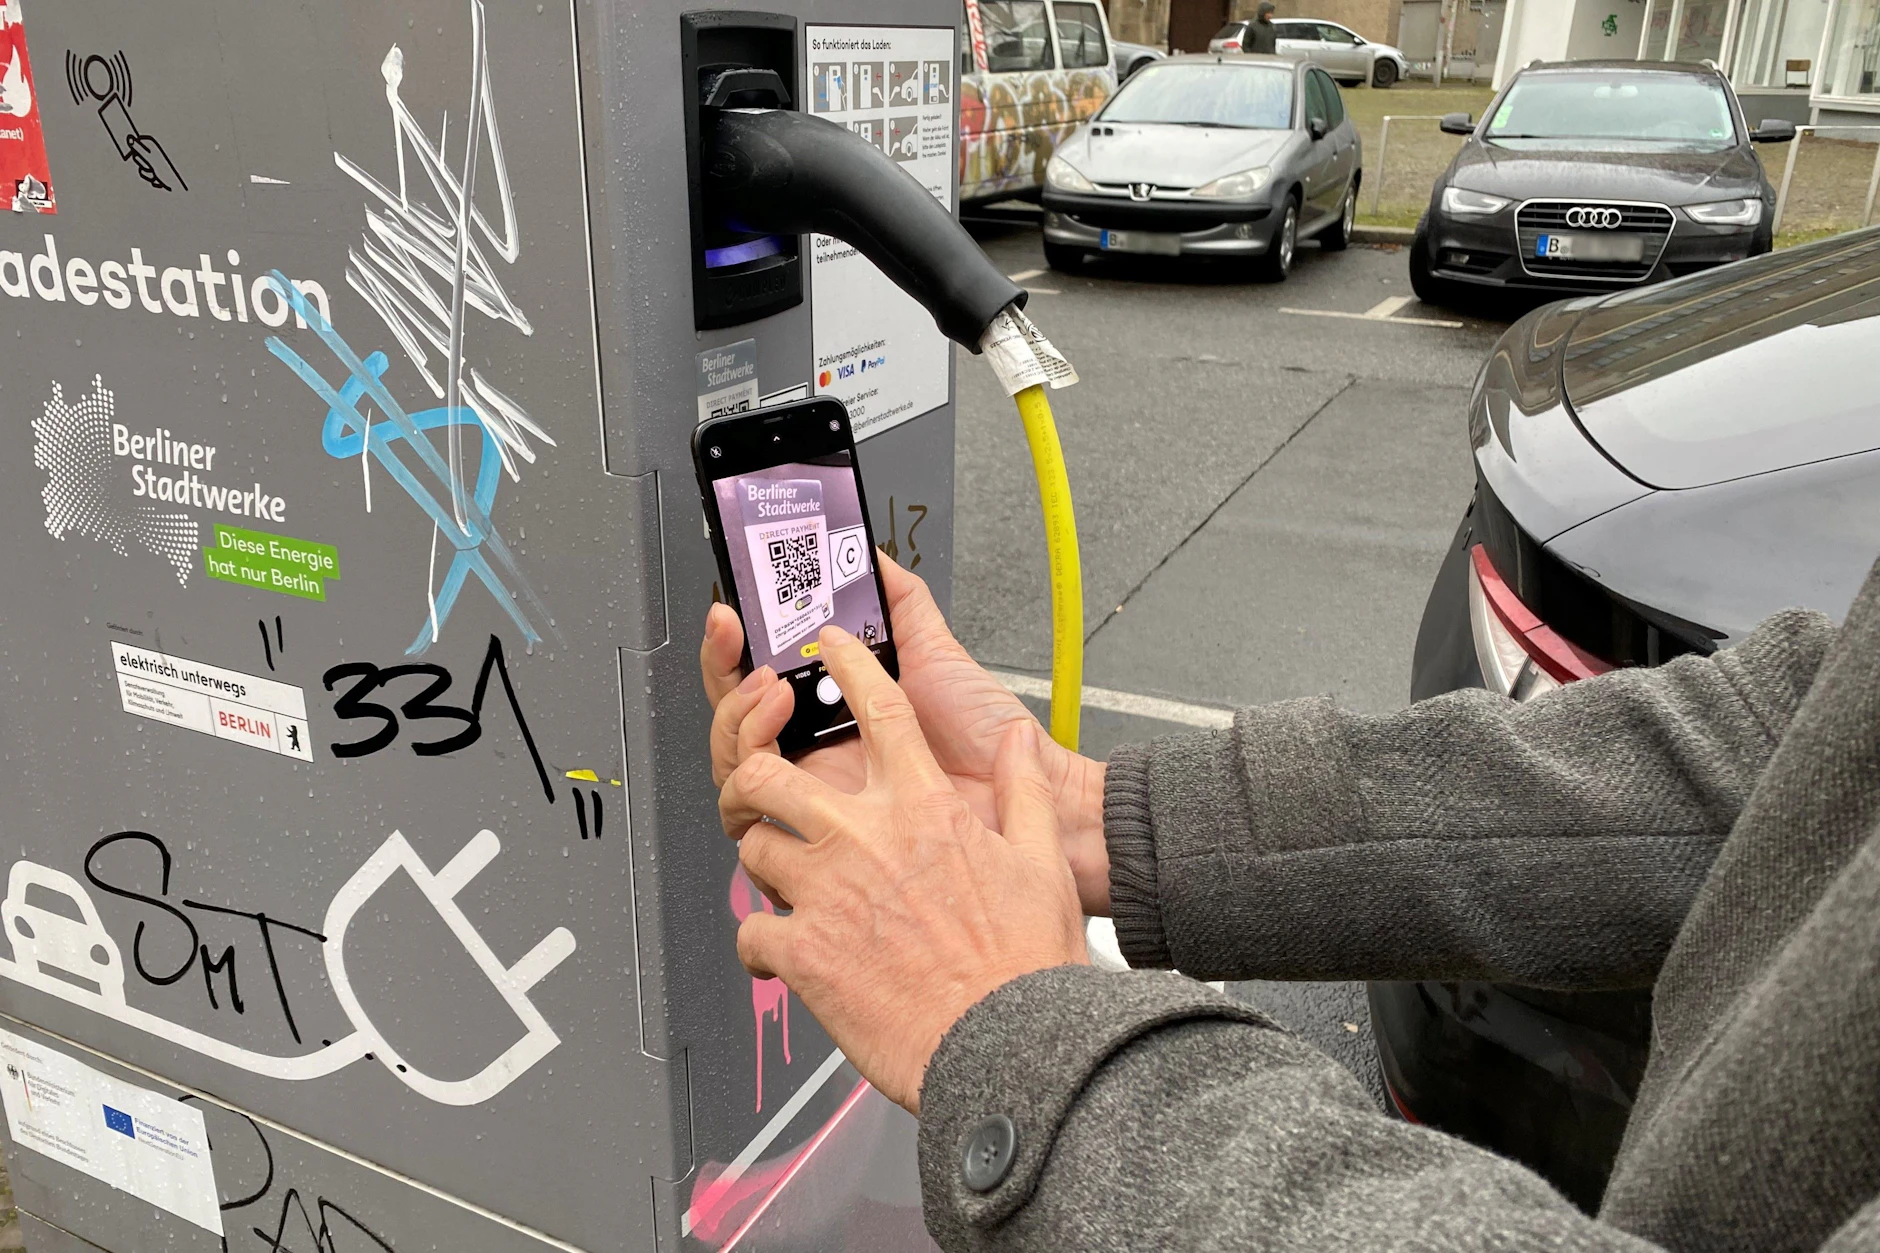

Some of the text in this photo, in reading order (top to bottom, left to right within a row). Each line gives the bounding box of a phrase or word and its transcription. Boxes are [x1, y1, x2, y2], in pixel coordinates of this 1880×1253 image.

[812, 38, 892, 50] So funktioniert das Laden:
[816, 236, 832, 248] Oder
[1549, 238, 1559, 253] B
[702, 353, 736, 373] Berliner
[818, 339, 886, 368] Zahlungsmöglichkeiten:
[707, 361, 754, 388] Stadtwerke
[837, 356, 886, 380] VISA PayPal
[706, 388, 753, 409] DIRECT PAYMENT
[856, 387, 879, 403] Service:
[852, 401, 914, 433] @berlinerstadtwerke.de
[113, 423, 216, 471] Berliner
[131, 464, 286, 523] Stadtwerke
[747, 484, 798, 501] Berliner
[758, 498, 820, 518] Stadtwerke
[759, 522, 820, 541] DIRECT PAYMENT
[219, 531, 334, 572] Diese Energie
[846, 547, 855, 564] C
[208, 554, 320, 594] hat nur Berlin
[120, 652, 247, 698] elektrisch unterwegs
[795, 670, 811, 680] VIDEO
[218, 710, 272, 739] BERLIN
